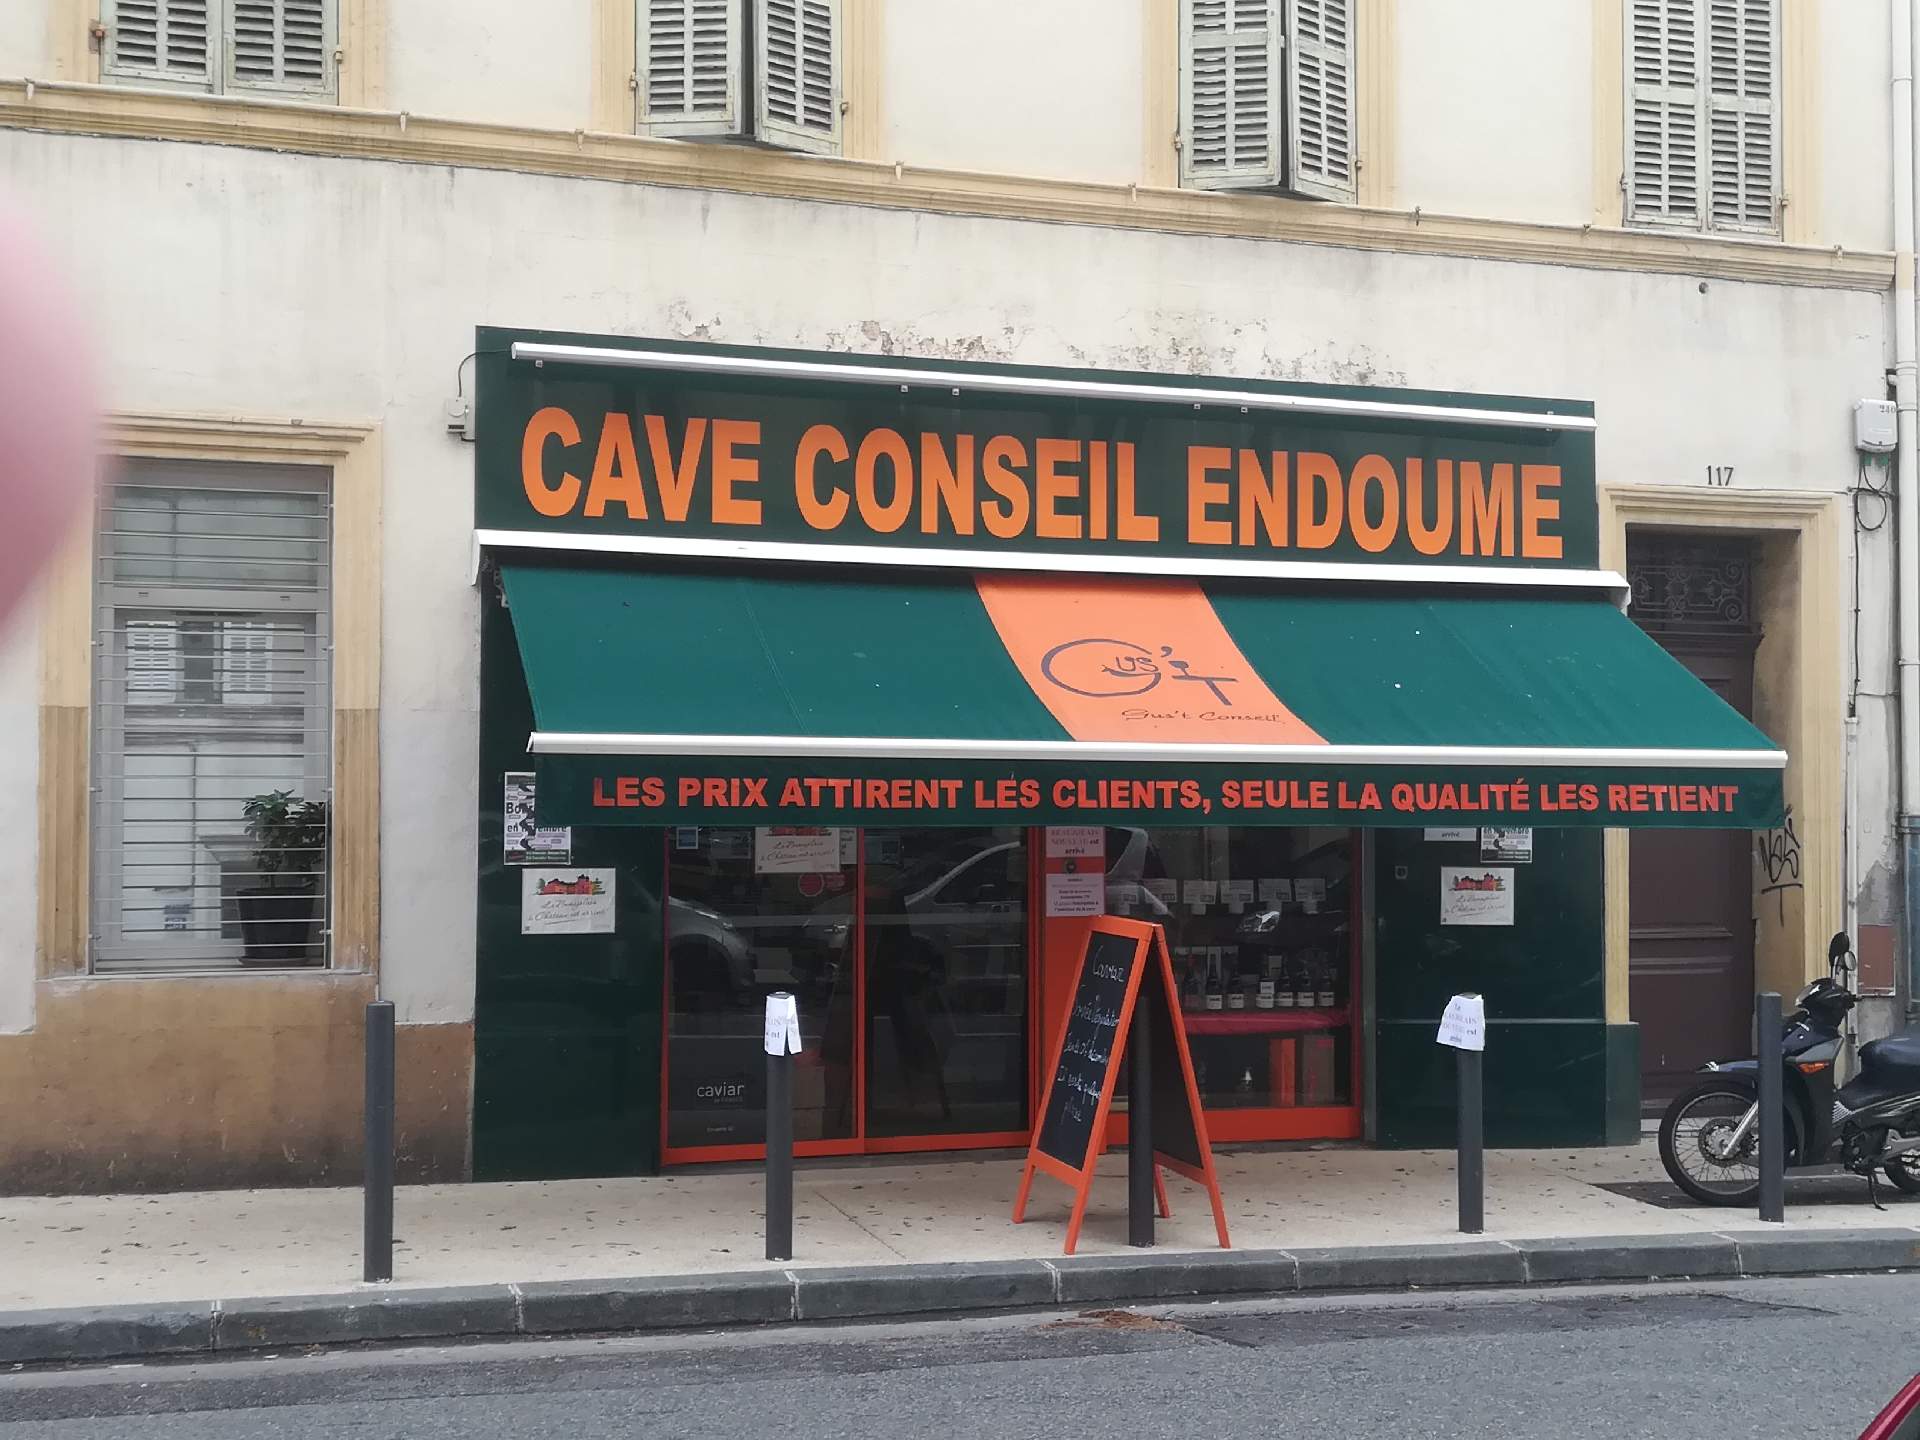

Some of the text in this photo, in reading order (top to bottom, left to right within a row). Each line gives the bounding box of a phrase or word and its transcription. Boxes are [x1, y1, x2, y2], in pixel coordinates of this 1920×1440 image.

[521, 407, 1564, 559] CAVE CONSEIL ENDOUME
[1706, 465, 1735, 487] 117
[592, 777, 665, 808] LES
[678, 778, 769, 808] PRIX
[778, 778, 962, 809] ATTIRENT
[1052, 779, 1212, 815] CLIENTS,
[1221, 780, 1330, 810] SEULE
[1338, 781, 1383, 809] LA
[1391, 777, 1530, 812] QUALITÉ
[1540, 784, 1600, 811] LES
[1607, 784, 1738, 812] RETIENT
[696, 1081, 745, 1097] caviar
